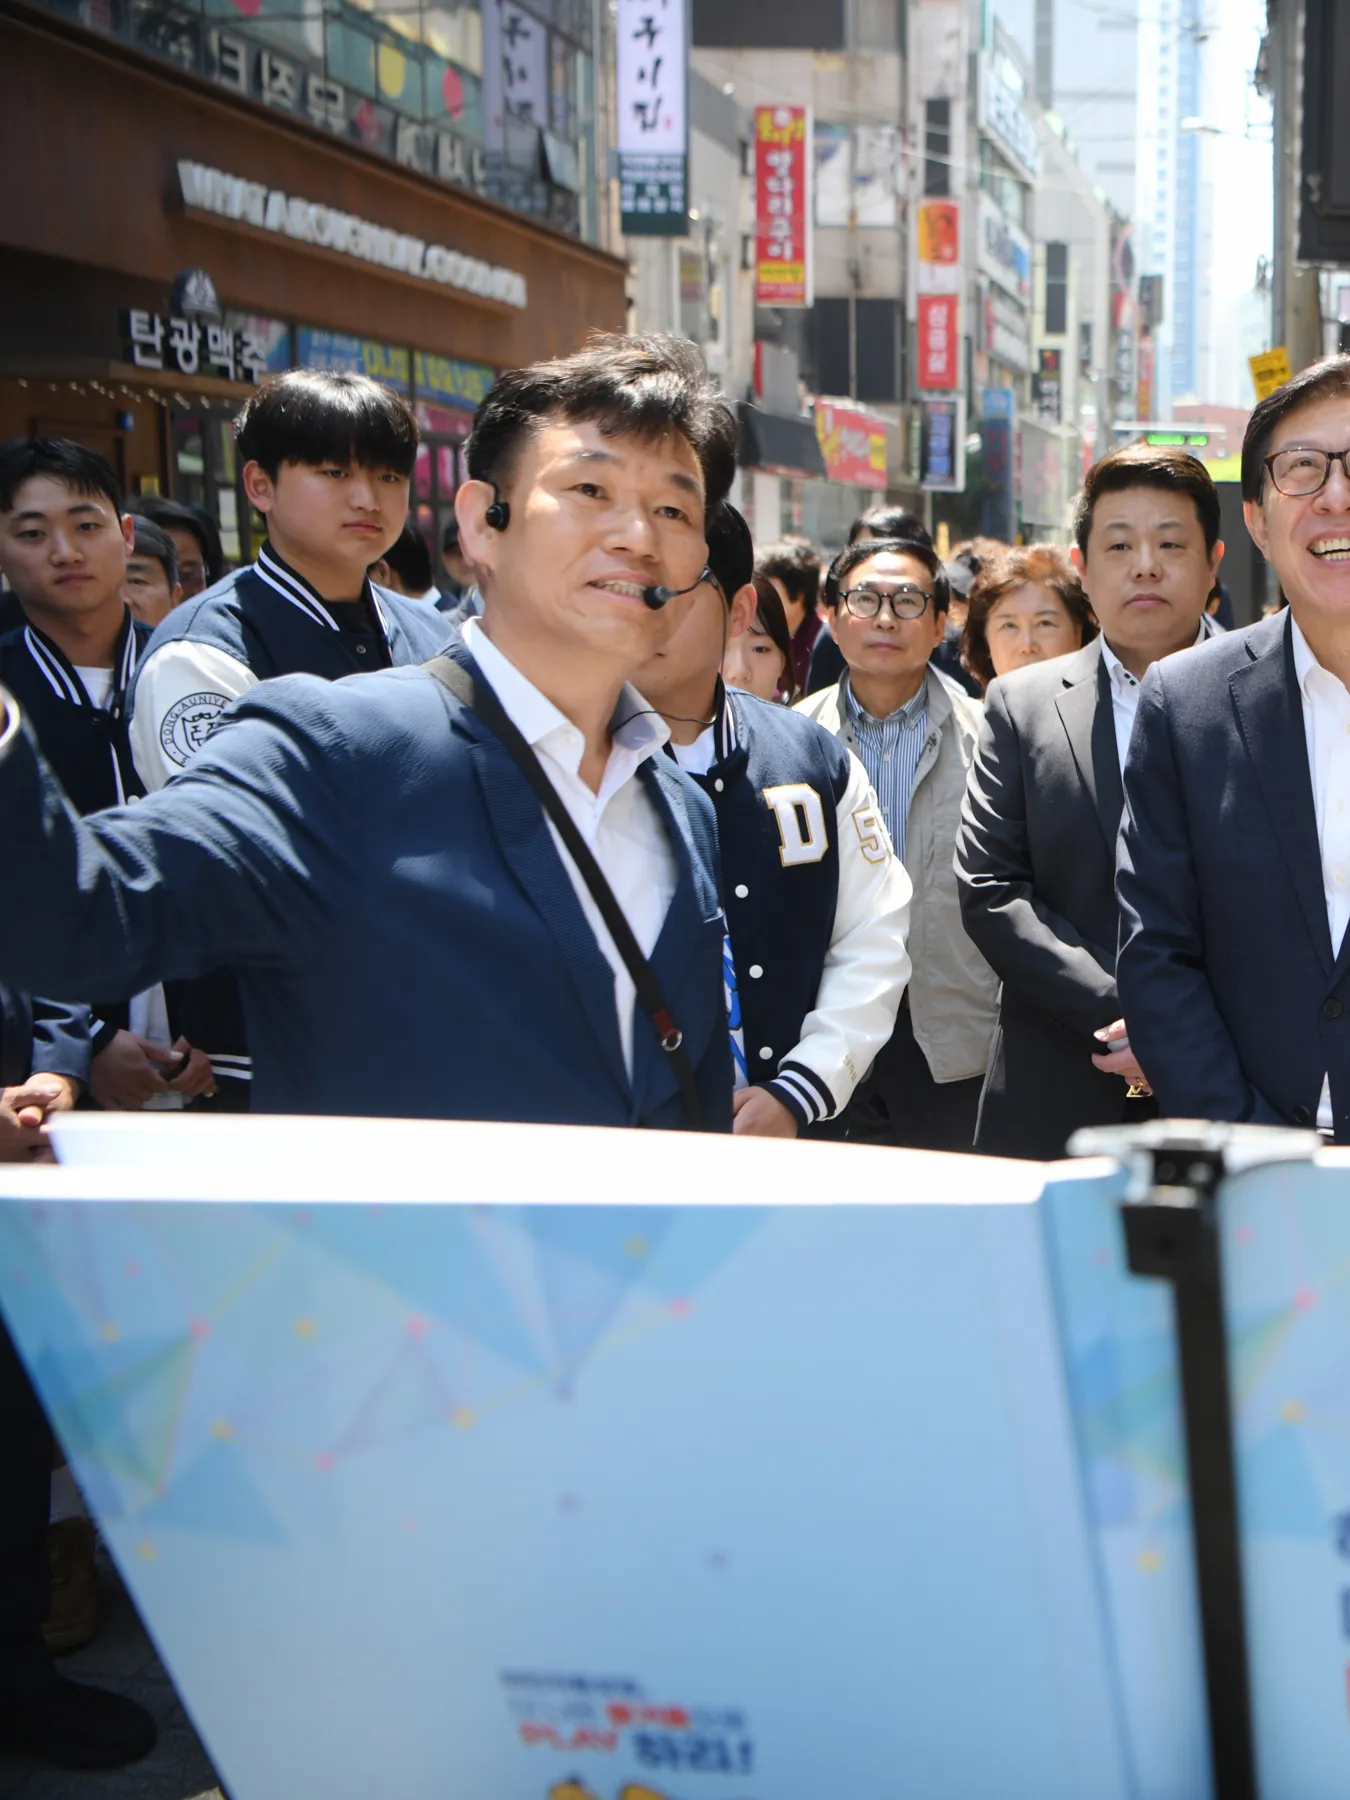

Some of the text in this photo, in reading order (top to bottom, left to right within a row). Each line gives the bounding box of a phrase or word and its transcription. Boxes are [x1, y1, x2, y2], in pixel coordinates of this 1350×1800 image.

[631, 0, 665, 134] 구이집
[130, 309, 268, 386] 탄광맥주
[762, 782, 829, 868] D
